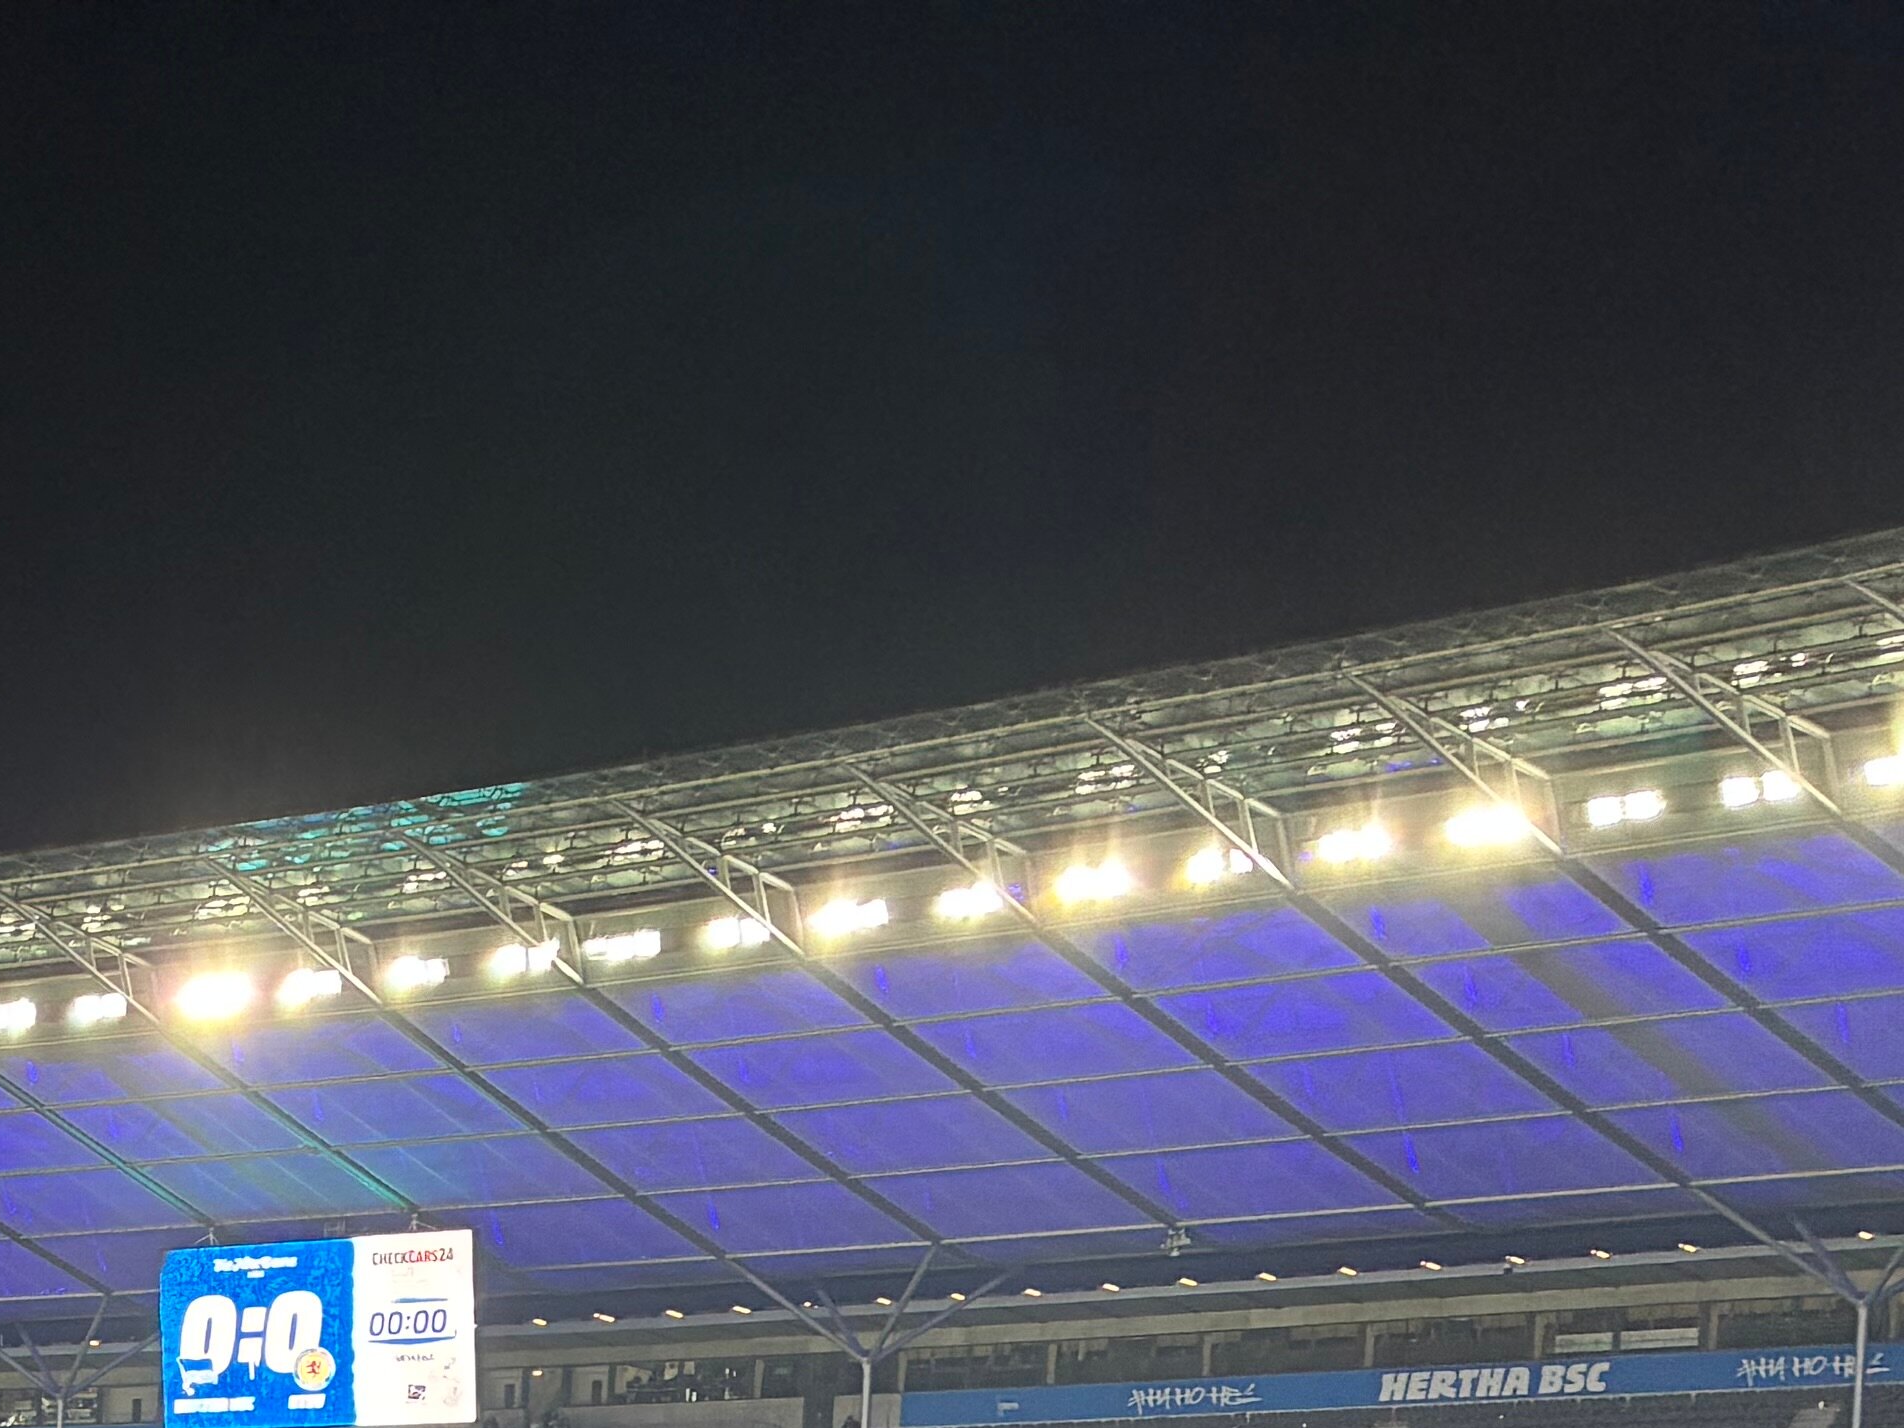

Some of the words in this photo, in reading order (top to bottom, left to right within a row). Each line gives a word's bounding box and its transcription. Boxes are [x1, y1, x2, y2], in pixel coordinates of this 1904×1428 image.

[369, 1309, 447, 1337] 00:00
[1379, 1367, 1530, 1401] HERTHA
[1538, 1362, 1610, 1394] BSC
